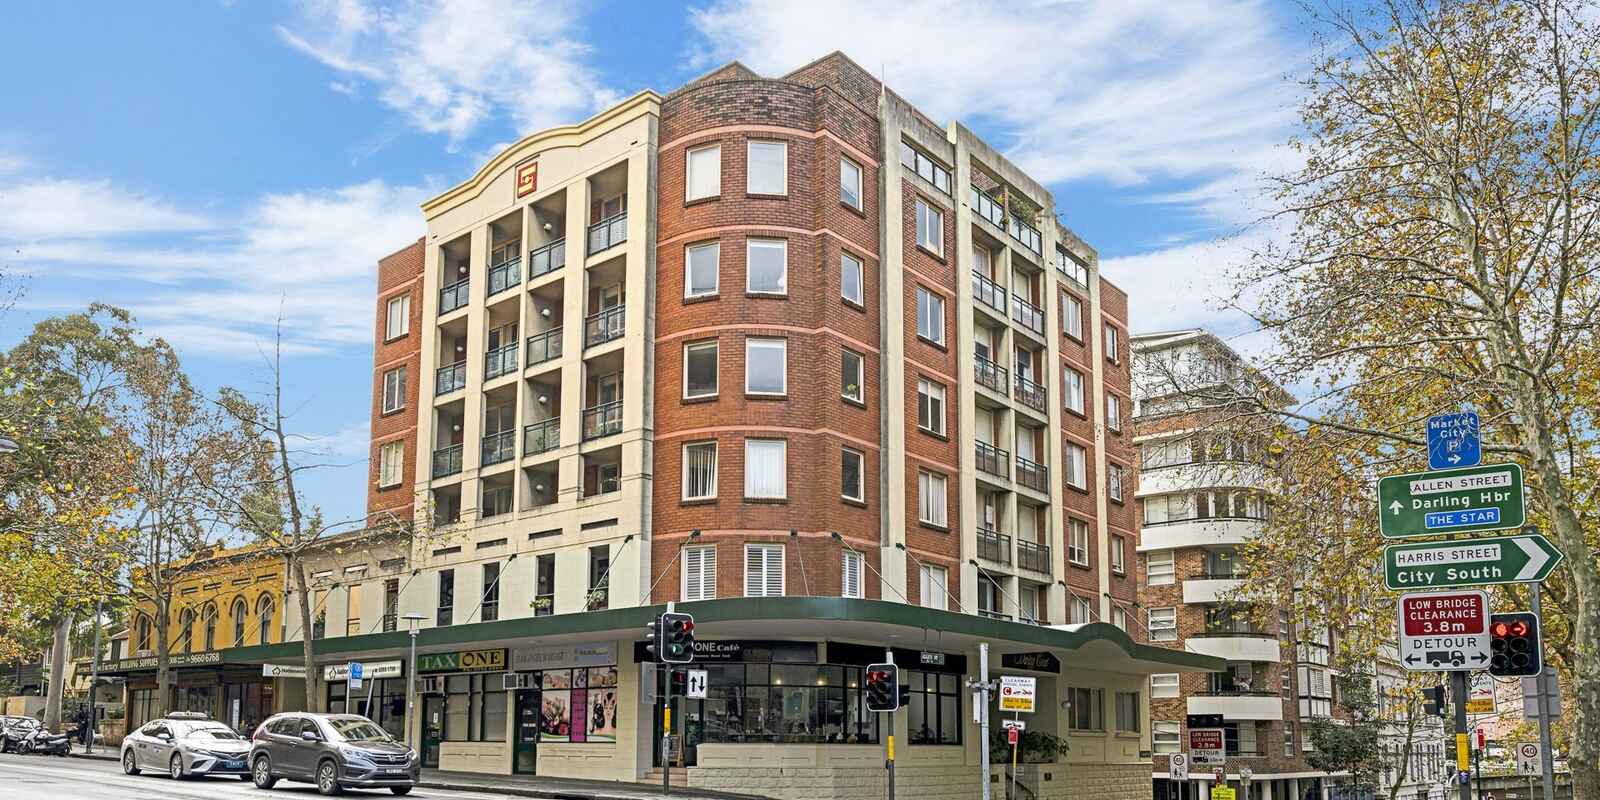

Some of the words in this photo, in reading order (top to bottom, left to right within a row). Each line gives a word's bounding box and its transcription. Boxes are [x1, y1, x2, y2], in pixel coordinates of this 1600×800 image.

[1431, 416, 1475, 430] Market
[1440, 429, 1466, 444] City
[1413, 481, 1453, 493] ALLEN
[1460, 474, 1508, 488] STREET
[1412, 495, 1470, 510] Darling
[1480, 491, 1511, 503] Hbr
[1429, 514, 1454, 525] THE
[1461, 511, 1495, 523] STAR
[1398, 551, 1445, 563] HARRIS
[1452, 547, 1498, 560] STREET
[1397, 570, 1435, 584] City
[1447, 566, 1502, 580] South
[1409, 600, 1431, 610] LOW
[1436, 598, 1477, 609] BRIDGE
[1410, 609, 1477, 620] CLEARANCE
[694, 642, 716, 652] ONE
[716, 643, 740, 652] Café
[1413, 637, 1477, 649] DETOUR
[139, 657, 159, 668] SUPPLIES
[421, 653, 456, 669] TAX
[462, 650, 501, 667] ONE
[1525, 747, 1535, 755] 40
